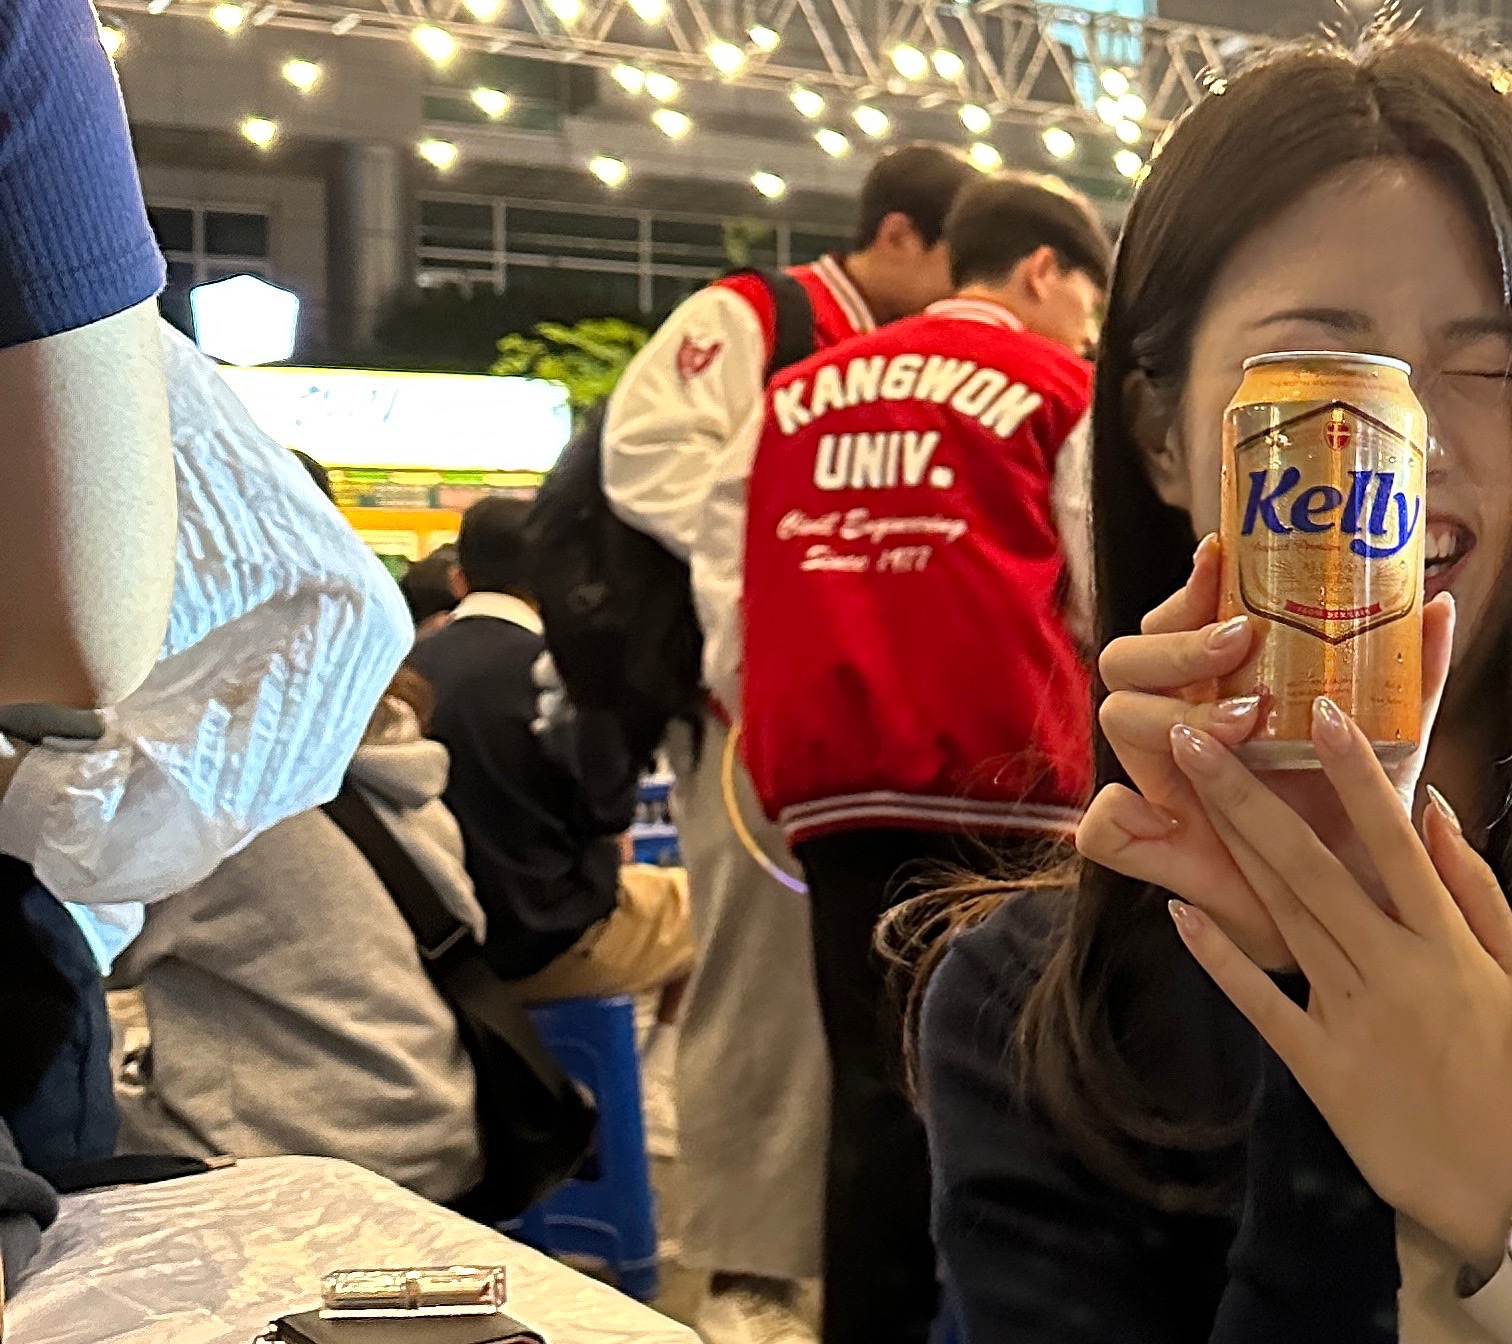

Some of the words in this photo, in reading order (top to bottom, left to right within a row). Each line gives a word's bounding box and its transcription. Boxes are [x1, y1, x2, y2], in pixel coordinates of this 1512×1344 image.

[772, 354, 1044, 439] KANGWON
[814, 430, 955, 490] UNIV.
[1241, 466, 1421, 559] Kelly
